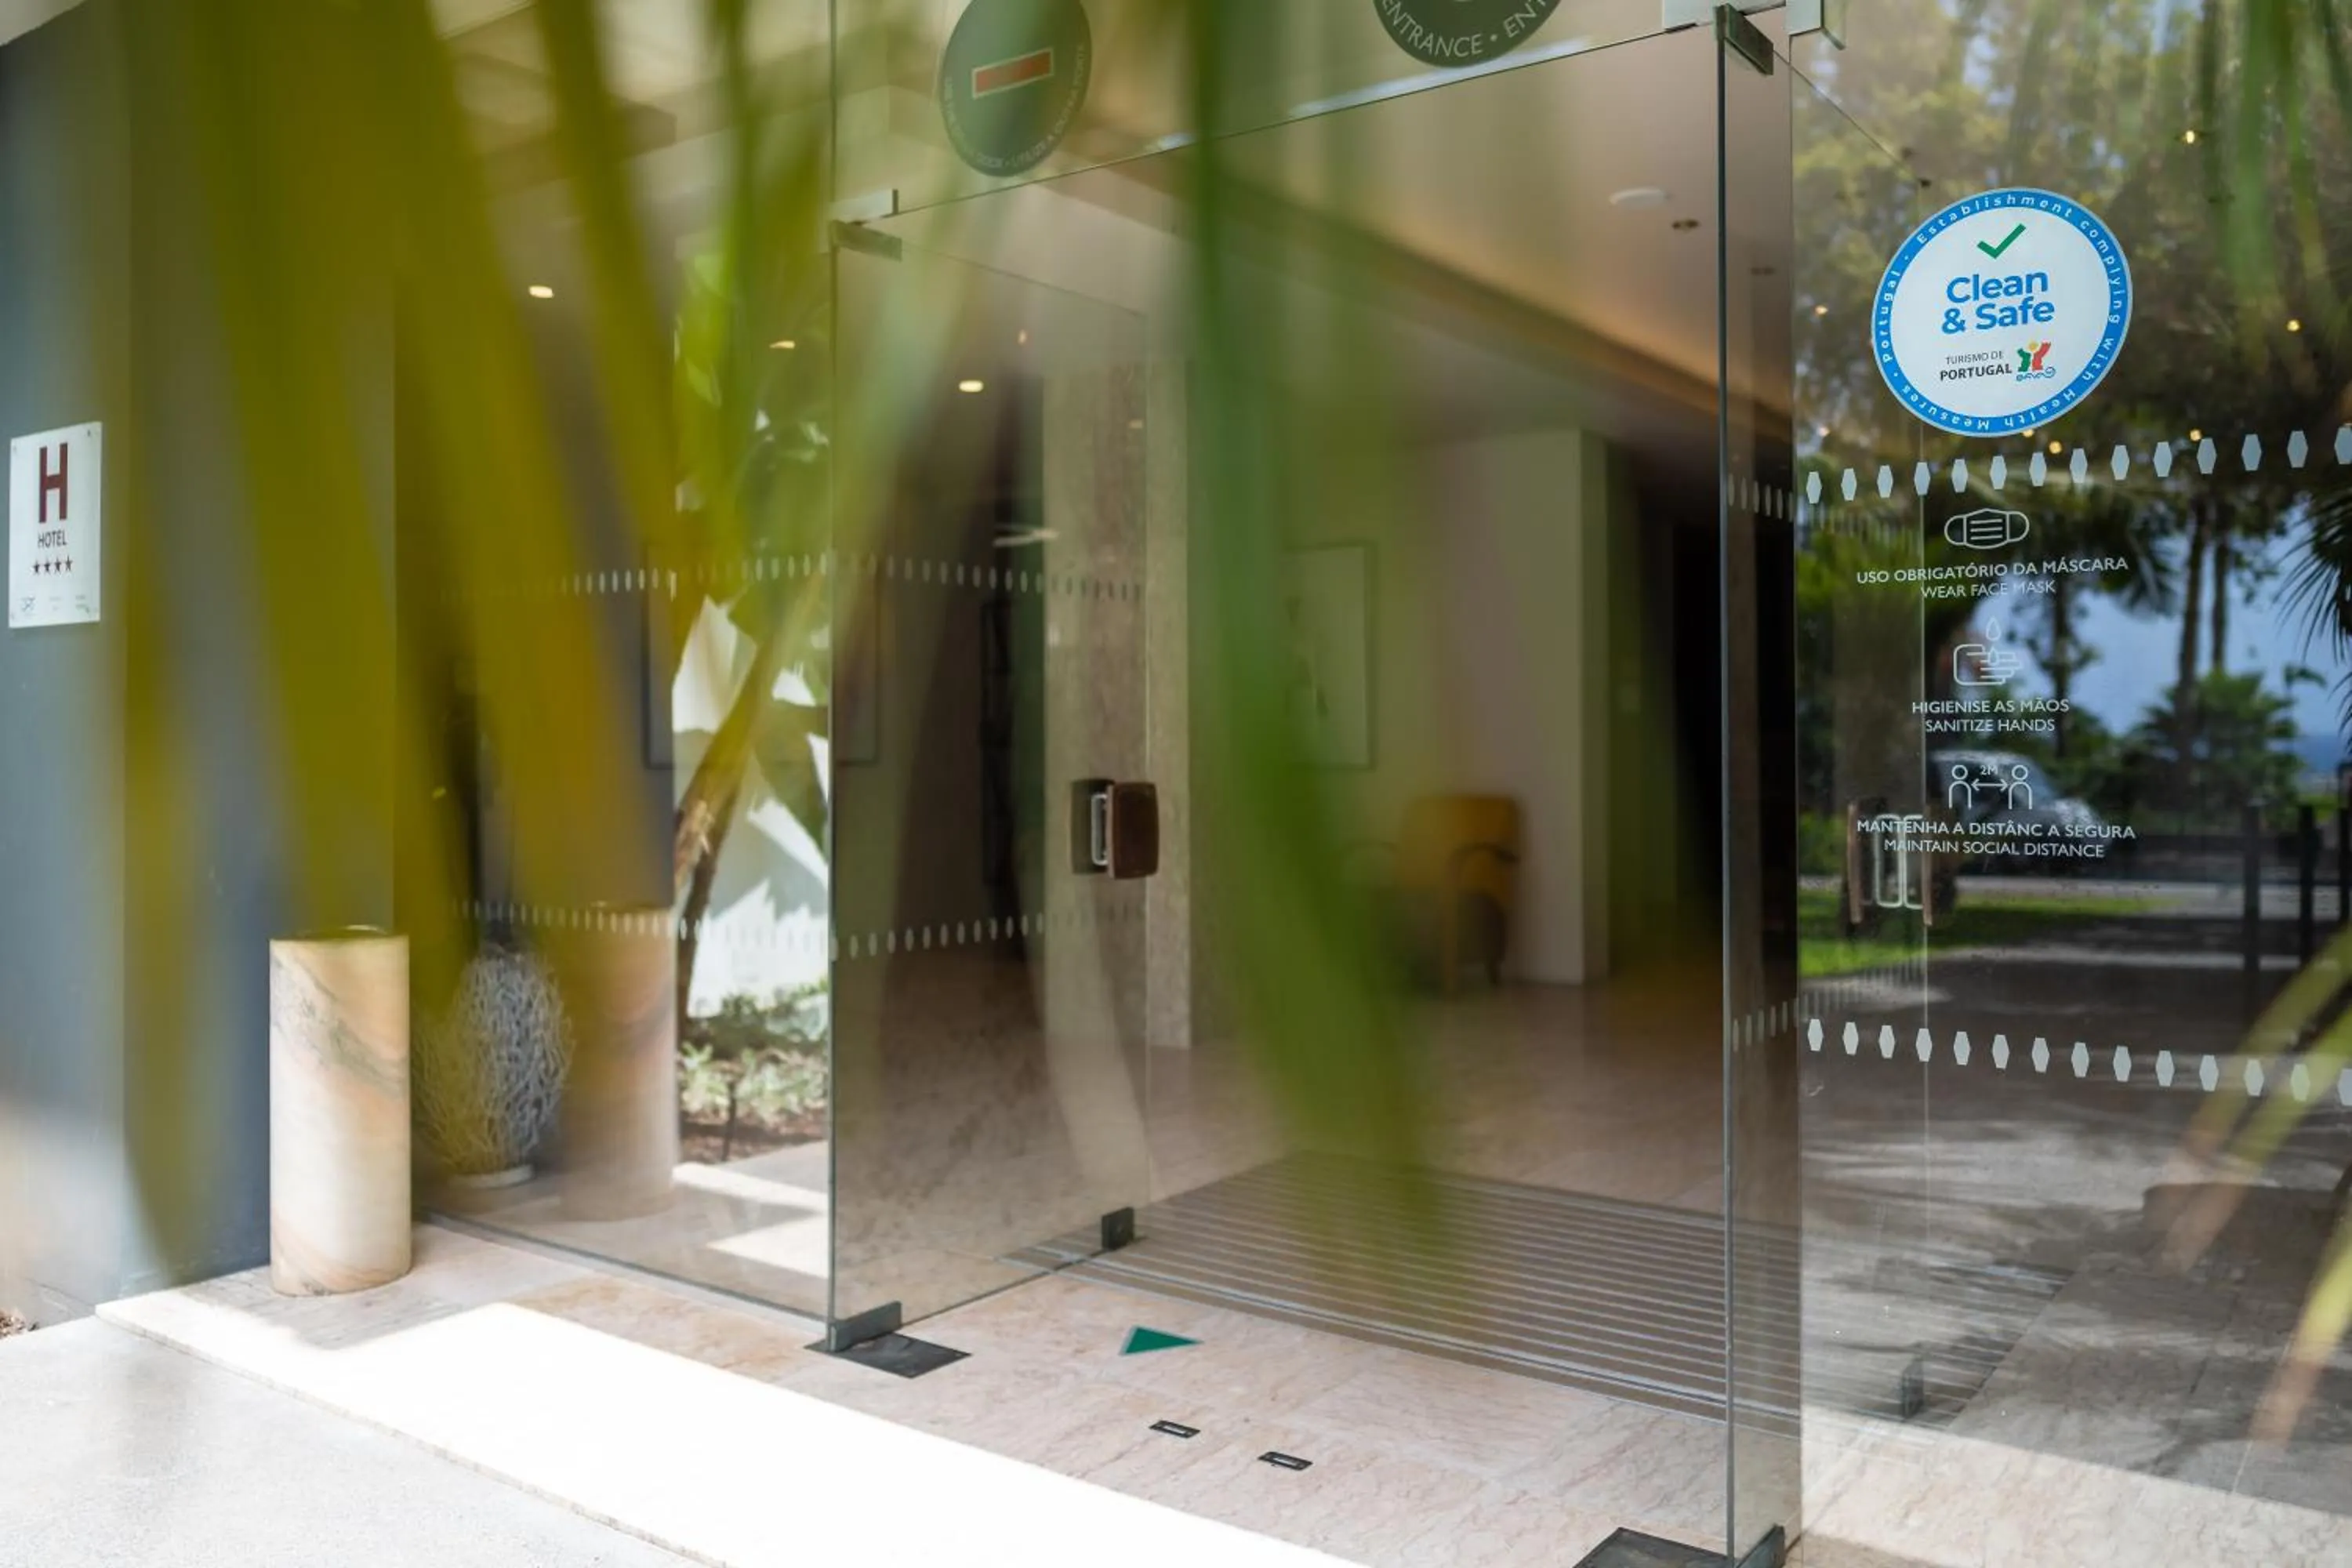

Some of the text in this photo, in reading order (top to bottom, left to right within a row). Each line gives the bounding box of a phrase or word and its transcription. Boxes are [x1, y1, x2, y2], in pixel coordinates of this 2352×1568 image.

[1946, 271, 2049, 304] Clean
[1880, 194, 2122, 430] Establishment complying with Health Measures Portugal
[1941, 296, 2055, 335] & Safe
[1945, 350, 2004, 365] TURISMO DE
[1940, 363, 2013, 381] PORTUGAL
[38, 442, 68, 524] H
[38, 529, 67, 548] HOTEL
[1857, 556, 2129, 584] USO OBRIGATÓRIO DA MÁSCARA
[1921, 580, 2056, 599] WEAR FACE MASK
[1912, 697, 2070, 713] HIGIENISE AS MÃOS
[1925, 719, 2055, 733] SANITIZE HANDS
[1980, 764, 1998, 775] 2M
[1857, 820, 1947, 834] MANTENHA
[1953, 822, 1965, 835] A
[2066, 824, 2136, 840] SEGURA
[1884, 839, 2105, 858] MAINTAIN SOCIAL DISTANCE
